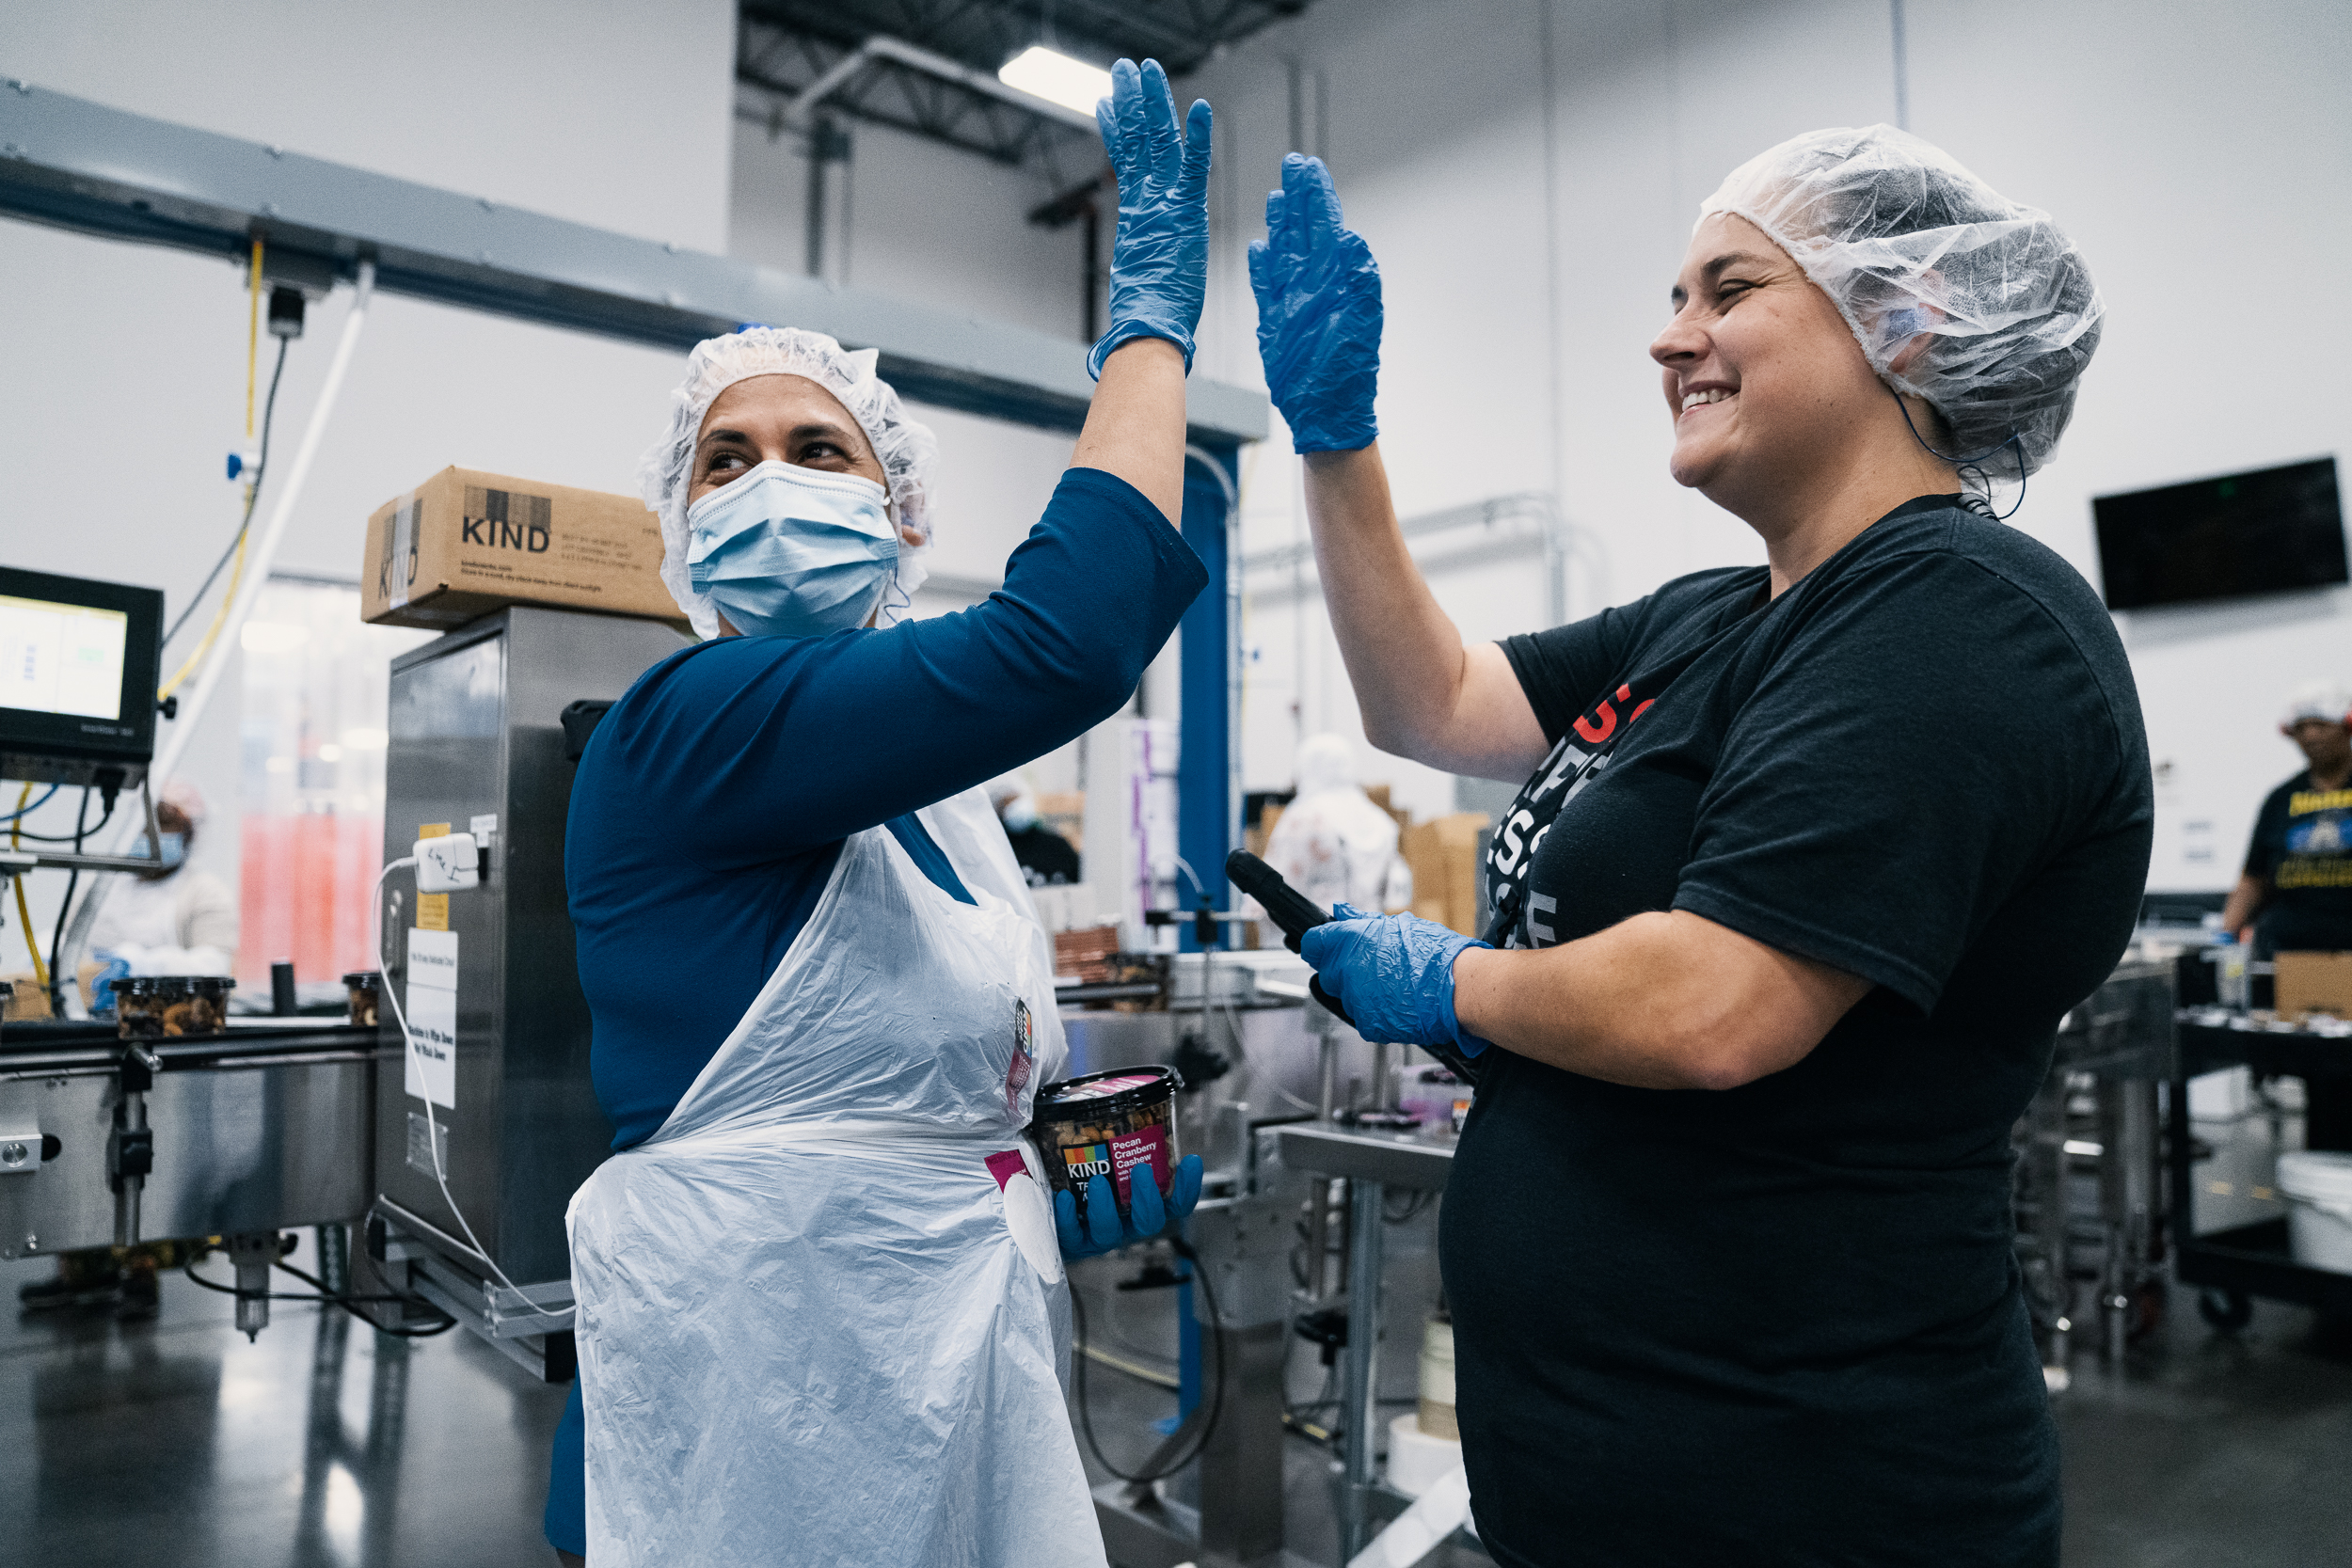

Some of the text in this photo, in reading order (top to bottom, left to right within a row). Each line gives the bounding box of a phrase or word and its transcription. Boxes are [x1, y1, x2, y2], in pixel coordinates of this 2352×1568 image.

[462, 515, 550, 553] KIND
[1113, 1138, 1141, 1150] Pecan
[1114, 1142, 1157, 1160] Cranberry
[1067, 1160, 1111, 1179] KIND
[1116, 1154, 1152, 1169] Cashew
[1118, 1167, 1129, 1176] with
